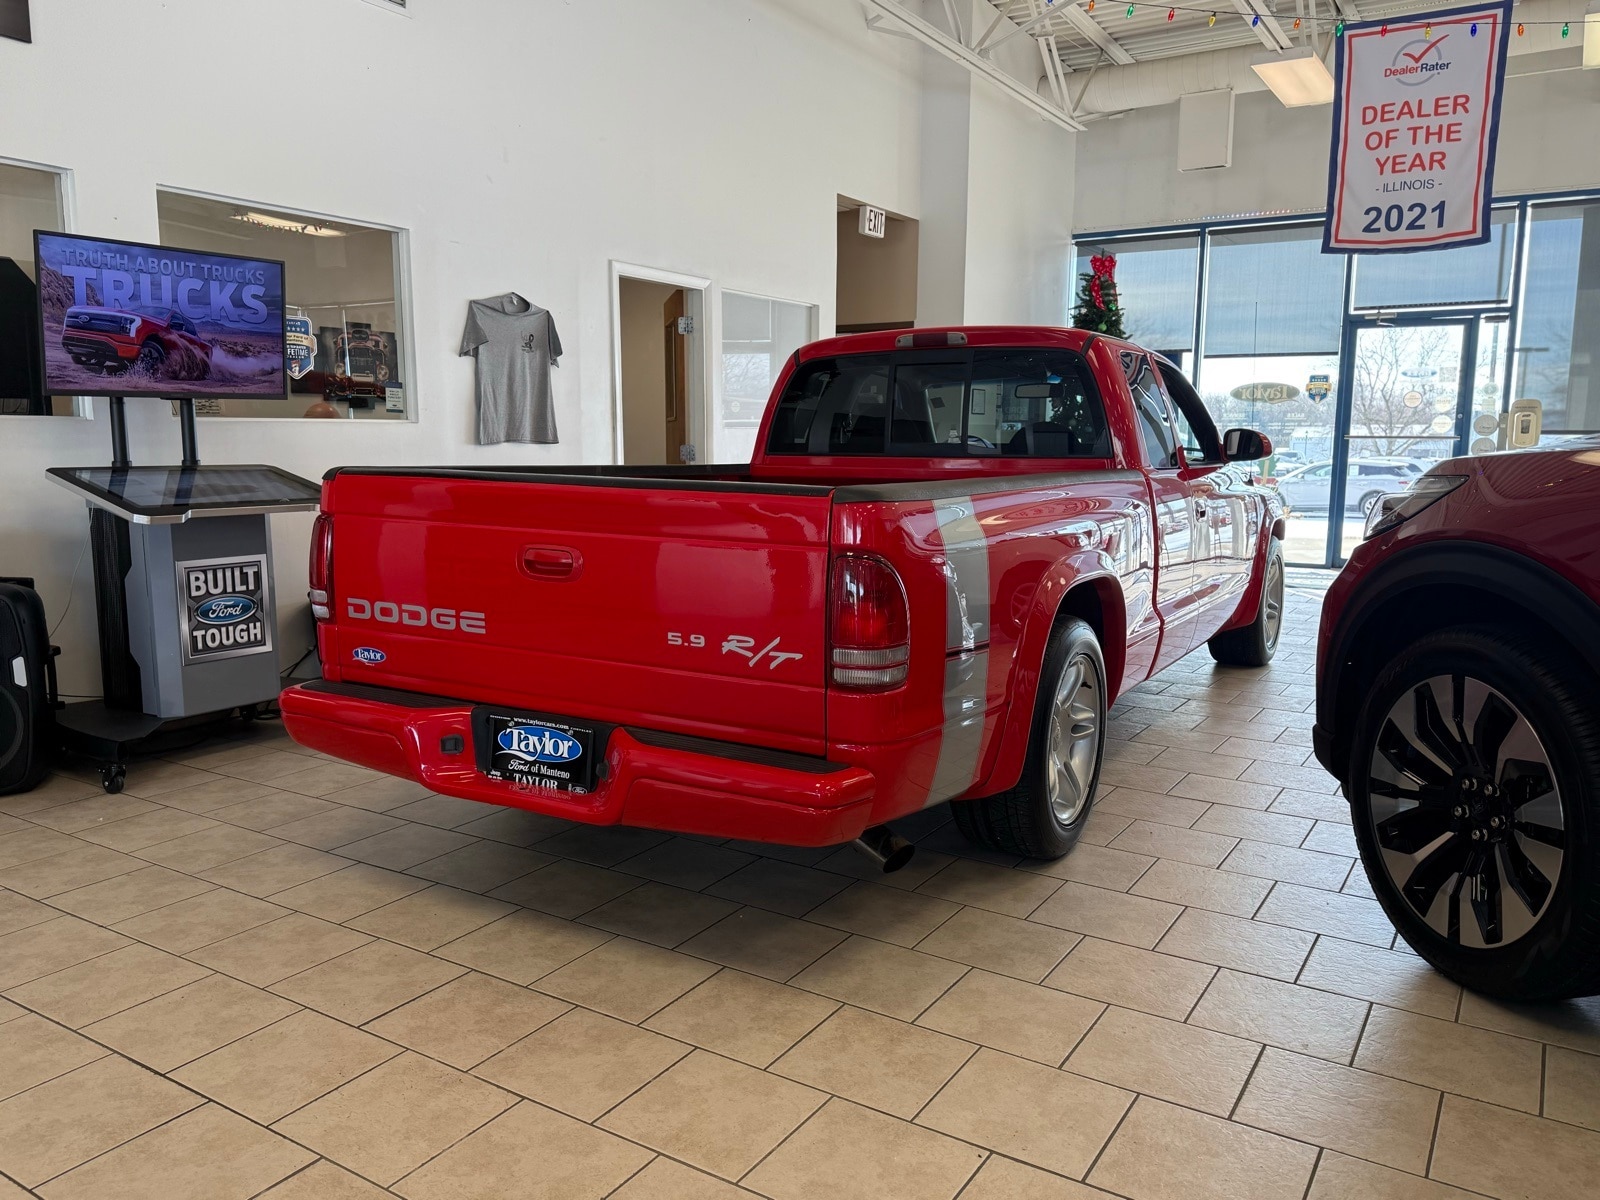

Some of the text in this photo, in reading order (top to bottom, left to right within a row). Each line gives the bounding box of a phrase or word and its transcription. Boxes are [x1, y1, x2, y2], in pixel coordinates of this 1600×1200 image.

[1384, 62, 1451, 78] DealerRater
[1361, 94, 1470, 125] DEALER
[1365, 122, 1462, 151] OF THE
[1375, 151, 1447, 175] YEAR
[1382, 178, 1435, 193] ILLINOIS
[868, 209, 884, 235] EXIT
[1361, 200, 1446, 233] 2021
[61, 248, 265, 285] TRUTH ABOUT TRUCKS
[62, 264, 269, 325] TRUCKS
[287, 348, 308, 357] FETIME
[189, 565, 259, 597] BUILT
[208, 600, 243, 618] Ford
[347, 597, 486, 634] DODGE
[192, 622, 262, 650] TOUGH
[355, 648, 382, 662] Taylor
[667, 631, 804, 670] 5.9 R/T
[513, 716, 570, 730] www.taylorcars.com
[497, 727, 574, 761] Taylor
[508, 758, 570, 780] Ford of Manteno
[513, 772, 558, 790] TAYLOR
